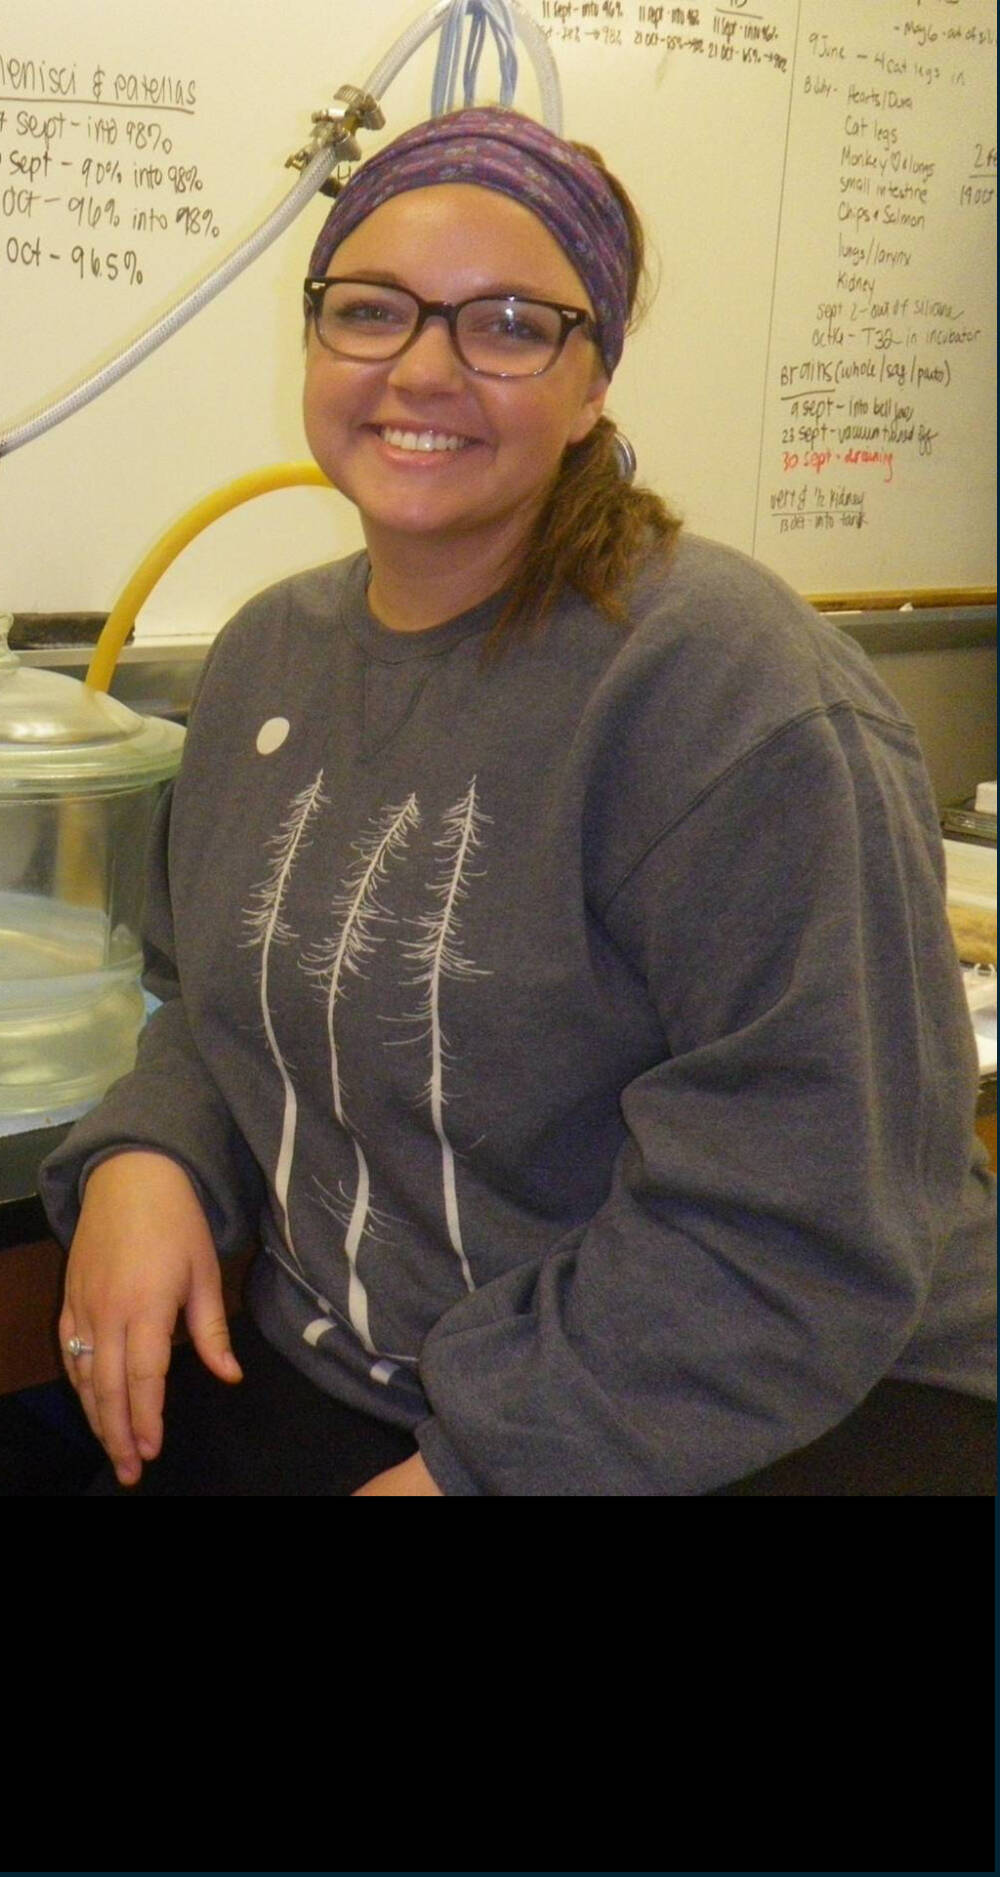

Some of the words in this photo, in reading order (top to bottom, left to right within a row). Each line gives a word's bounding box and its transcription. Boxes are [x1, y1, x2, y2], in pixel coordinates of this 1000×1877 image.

[87, 115, 118, 145] into
[126, 121, 172, 155] 98%
[81, 157, 122, 188] 90%
[134, 164, 163, 190] into
[168, 165, 203, 194] 98%
[2, 186, 41, 217] Oct
[68, 196, 121, 229] 96%
[132, 207, 168, 232] into
[176, 206, 220, 238] 98%
[6, 236, 42, 267] Oct
